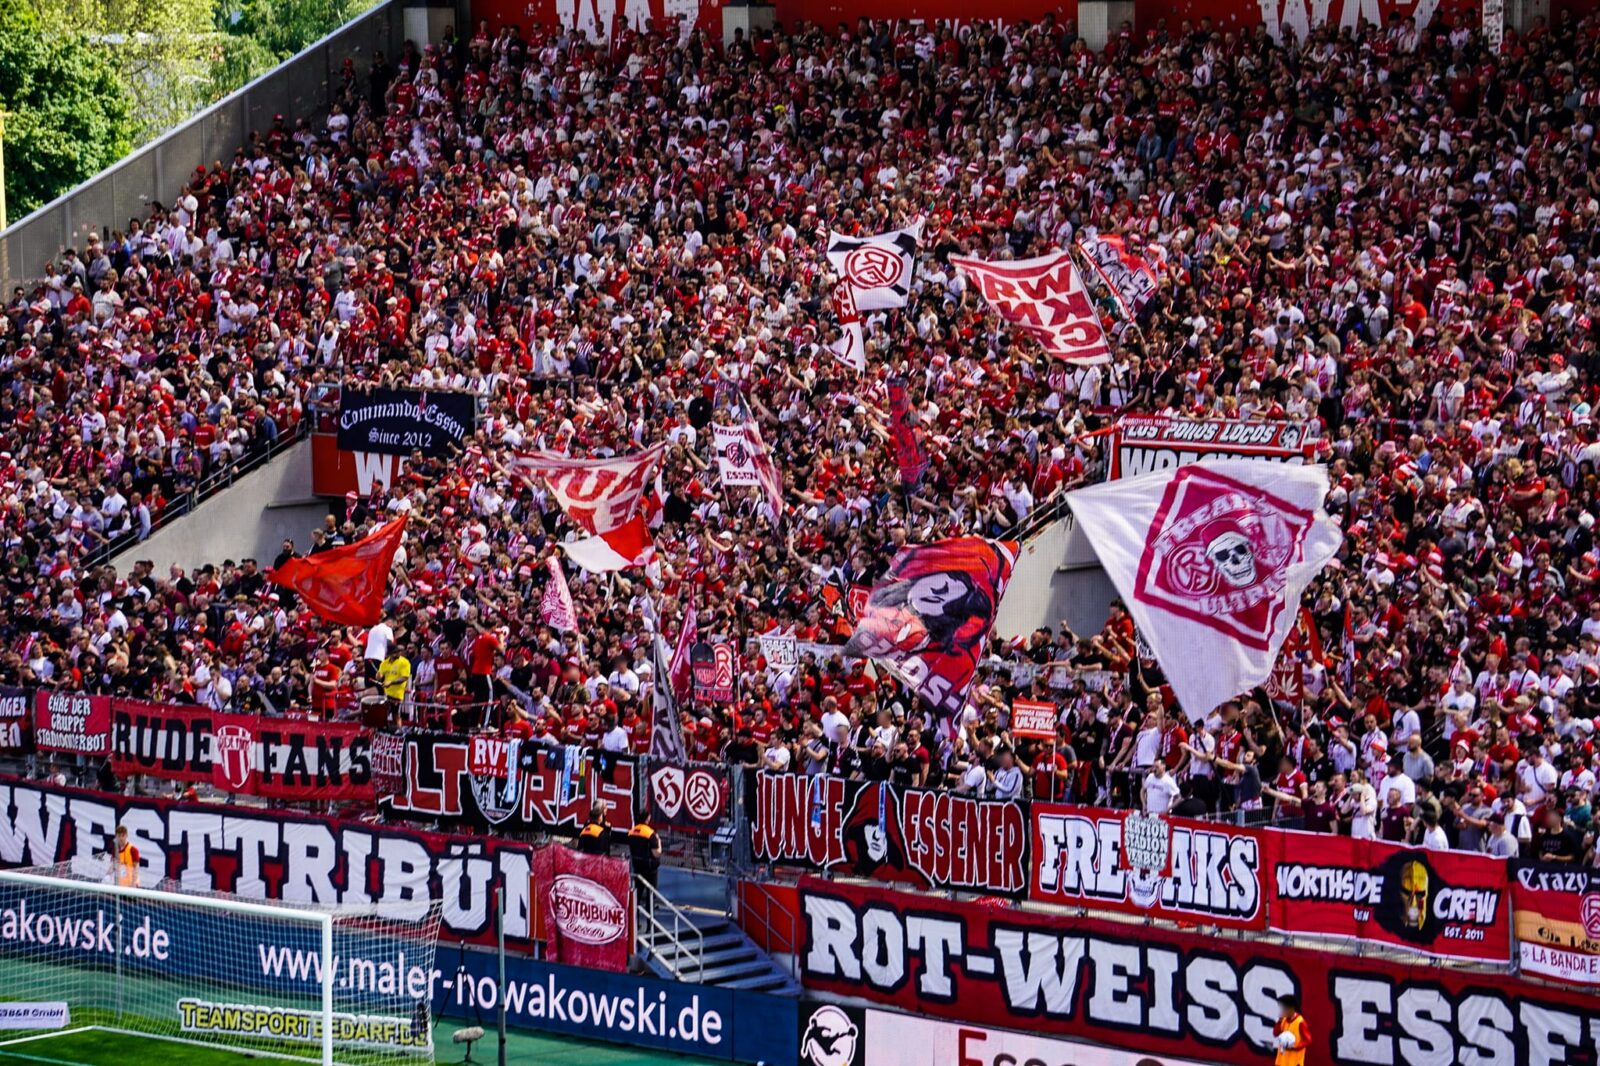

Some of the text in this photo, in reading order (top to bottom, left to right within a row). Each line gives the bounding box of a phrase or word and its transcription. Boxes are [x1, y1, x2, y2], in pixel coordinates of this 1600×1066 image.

[424, 403, 465, 441] Essen
[1219, 424, 1276, 443] LOCOS
[368, 427, 432, 447] Since 2012
[48, 695, 91, 715] EHRE DER
[51, 713, 85, 732] GRUPPE
[113, 712, 213, 774] RUDE
[260, 731, 372, 787] FANS
[752, 769, 1027, 894] JUNGE ESSENER
[1125, 834, 1168, 853] STADION
[1128, 850, 1166, 870] VERBOT
[1517, 867, 1588, 896] Crazy
[1433, 887, 1498, 924] CREW
[0, 899, 170, 960] akowski.de
[1444, 926, 1484, 941] EST. 2011
[804, 894, 1296, 1050] ROT-WEISS
[1532, 946, 1547, 964] LA
[1550, 951, 1587, 973] BANDA
[258, 941, 722, 1045] www.maler-nowakowski.de
[31, 1008, 64, 1017] GmbH
